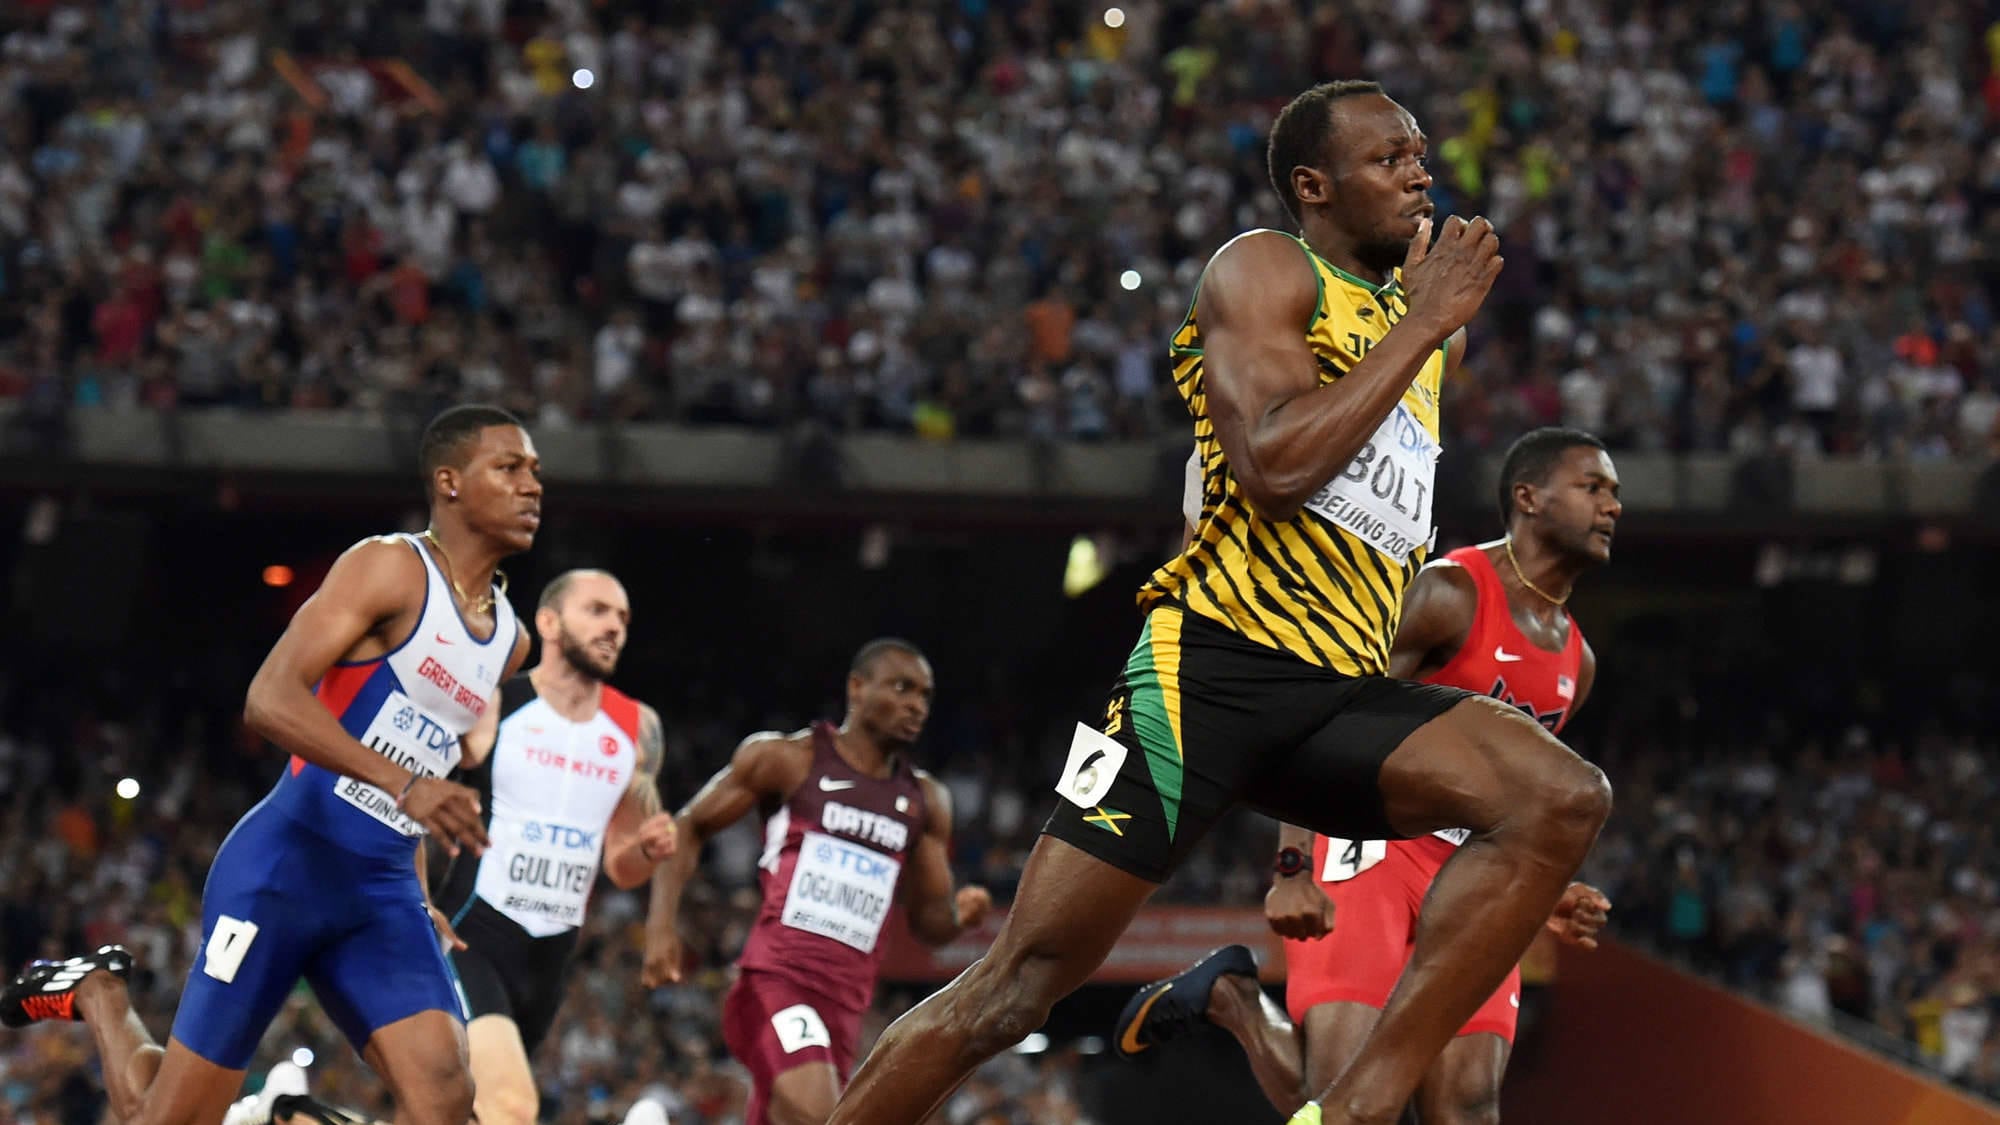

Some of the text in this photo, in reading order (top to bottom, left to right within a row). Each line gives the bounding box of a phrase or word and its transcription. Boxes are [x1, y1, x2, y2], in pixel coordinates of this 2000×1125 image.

[1343, 442, 1427, 522] BOLT
[1309, 487, 1387, 541] BEIJING
[418, 656, 458, 697] GREAT
[416, 713, 459, 761] TDK
[1073, 750, 1106, 795] 6
[344, 780, 401, 822] BEIJING
[545, 823, 595, 850] TDK
[822, 801, 908, 851] QATAR
[839, 848, 890, 885] TDK
[1340, 839, 1363, 872] 4
[790, 1016, 814, 1039] 2
